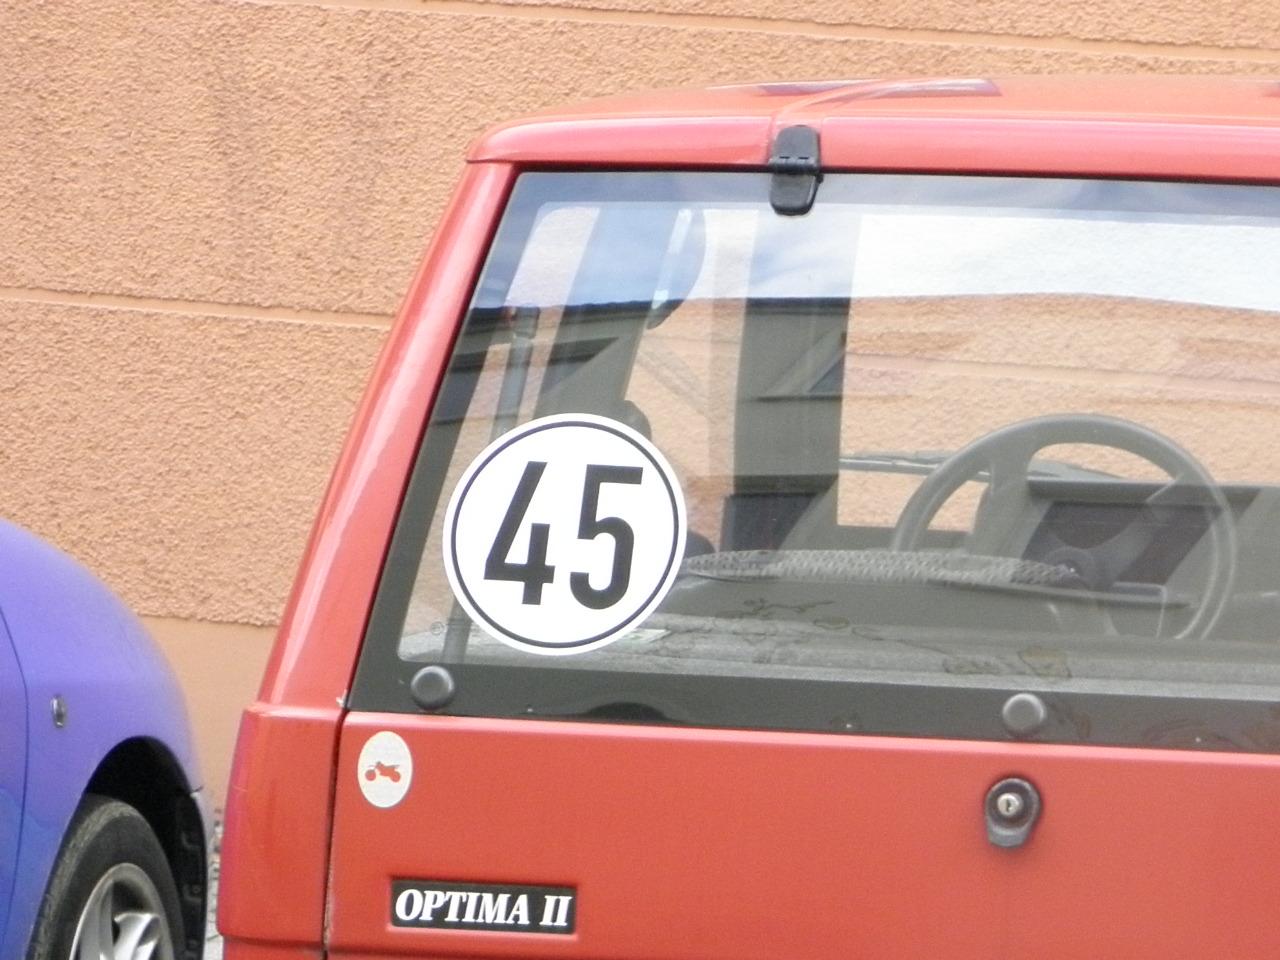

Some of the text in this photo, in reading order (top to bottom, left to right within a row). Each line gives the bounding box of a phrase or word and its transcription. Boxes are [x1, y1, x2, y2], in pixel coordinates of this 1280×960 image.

[484, 461, 643, 610] 45
[395, 889, 573, 926] OPTIMA II
